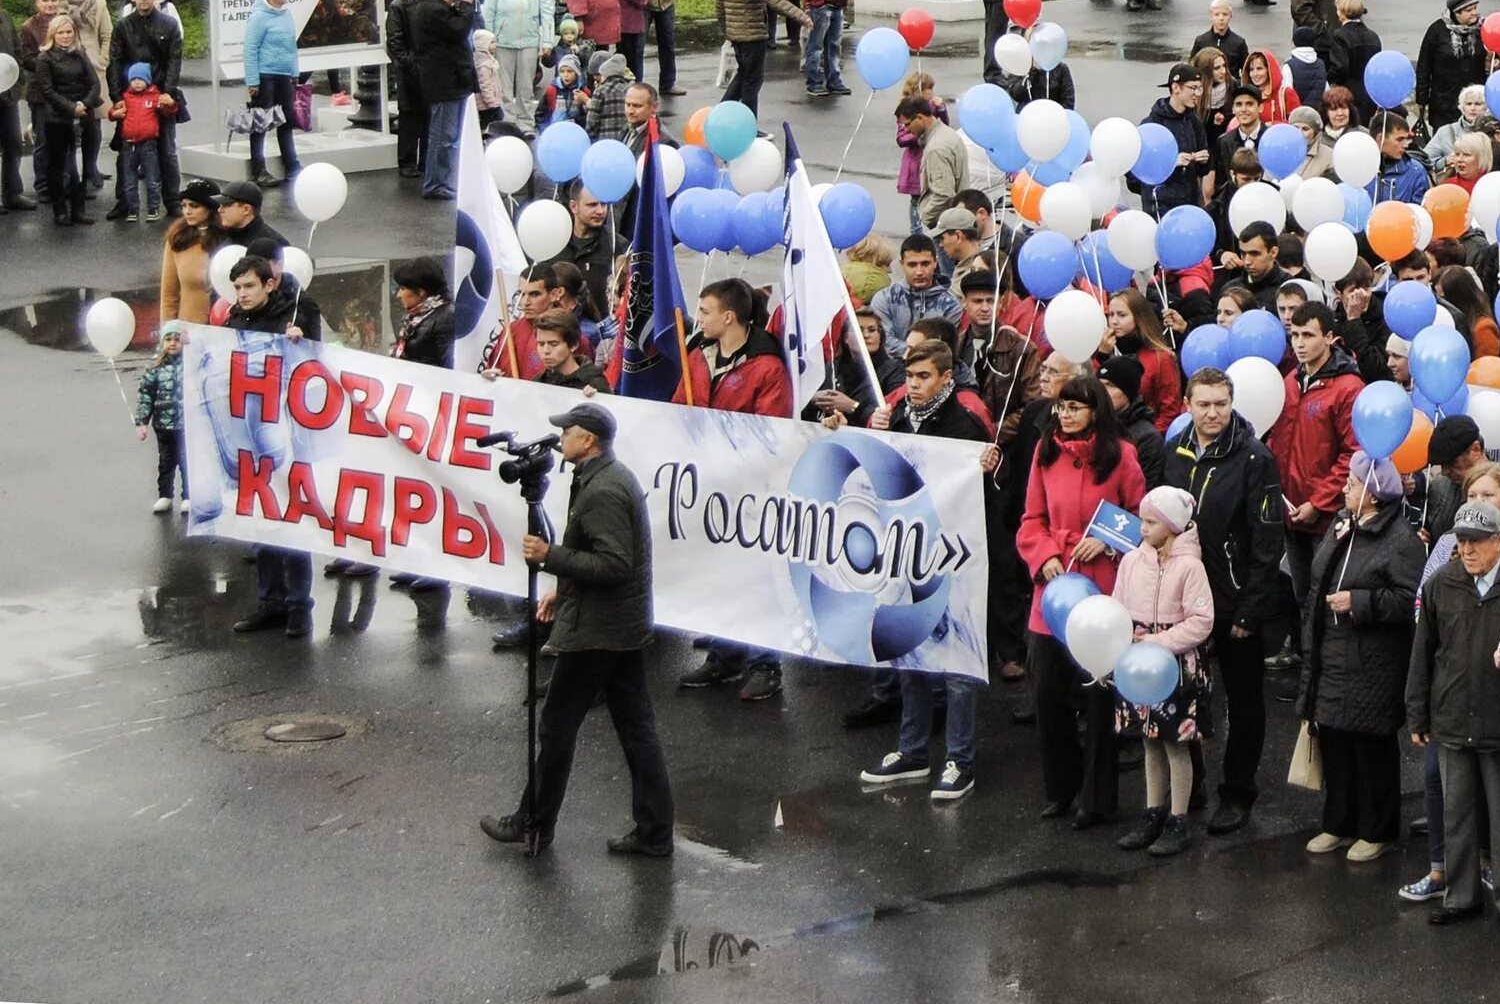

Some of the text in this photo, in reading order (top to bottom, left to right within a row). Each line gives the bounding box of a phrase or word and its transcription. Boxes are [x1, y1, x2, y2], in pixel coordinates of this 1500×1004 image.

[229, 350, 494, 471] НОВЫЕ
[235, 449, 505, 566] КАДРЫ
[648, 461, 972, 581] Росатом»
